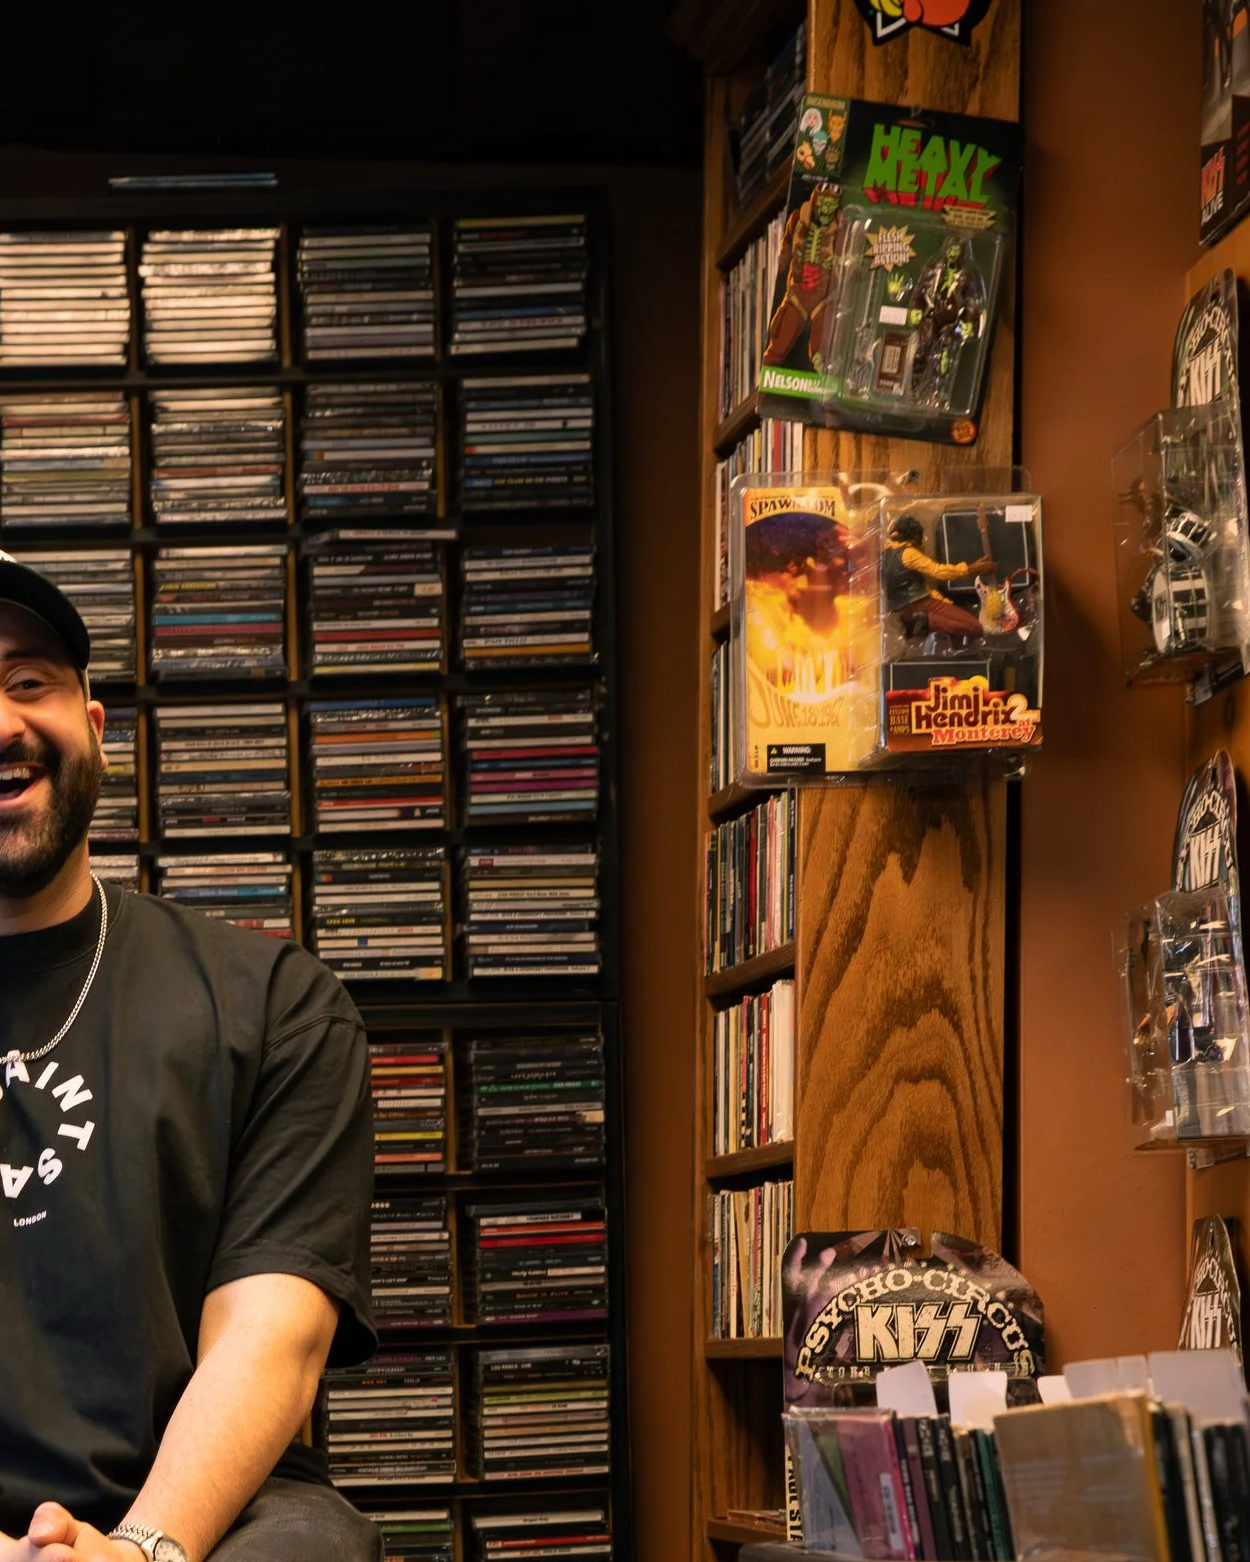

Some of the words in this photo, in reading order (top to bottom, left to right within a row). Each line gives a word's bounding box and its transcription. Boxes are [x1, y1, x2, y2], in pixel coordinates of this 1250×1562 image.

[871, 123, 1002, 179] HEAVY
[863, 158, 992, 206] METAL
[877, 229, 904, 244] FLESH
[872, 240, 910, 256] RIPPING
[872, 252, 911, 266] ACTION!
[929, 682, 981, 712] Jimi
[931, 724, 1036, 746] Monterey
[13, 1210, 47, 1228] LONDON
[853, 1301, 982, 1364] KISS
